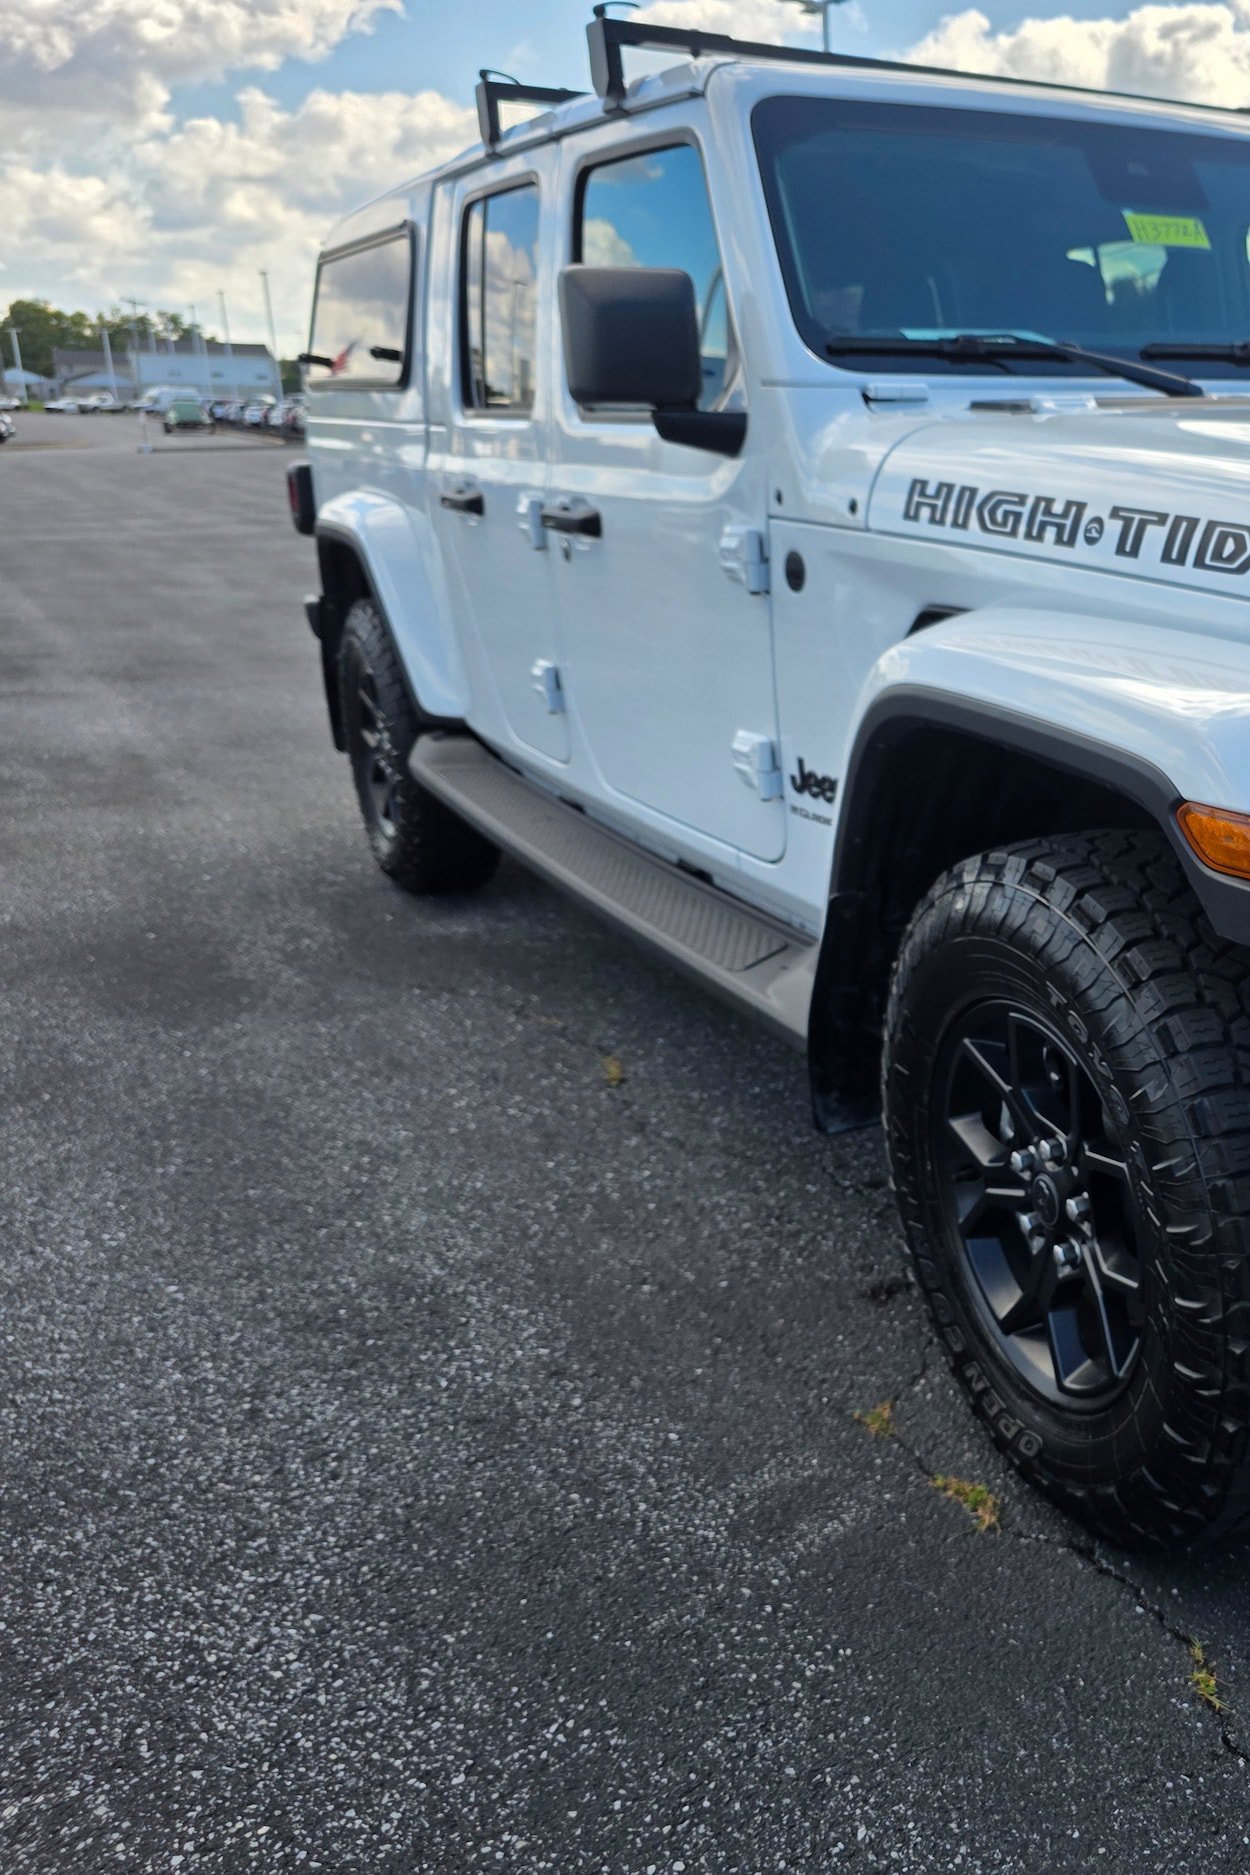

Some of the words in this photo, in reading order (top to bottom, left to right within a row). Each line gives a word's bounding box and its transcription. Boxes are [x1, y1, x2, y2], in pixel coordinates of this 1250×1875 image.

[903, 478, 1087, 549] HIGH
[789, 756, 839, 804] Jee
[962, 1360, 1043, 1457] OPEN
